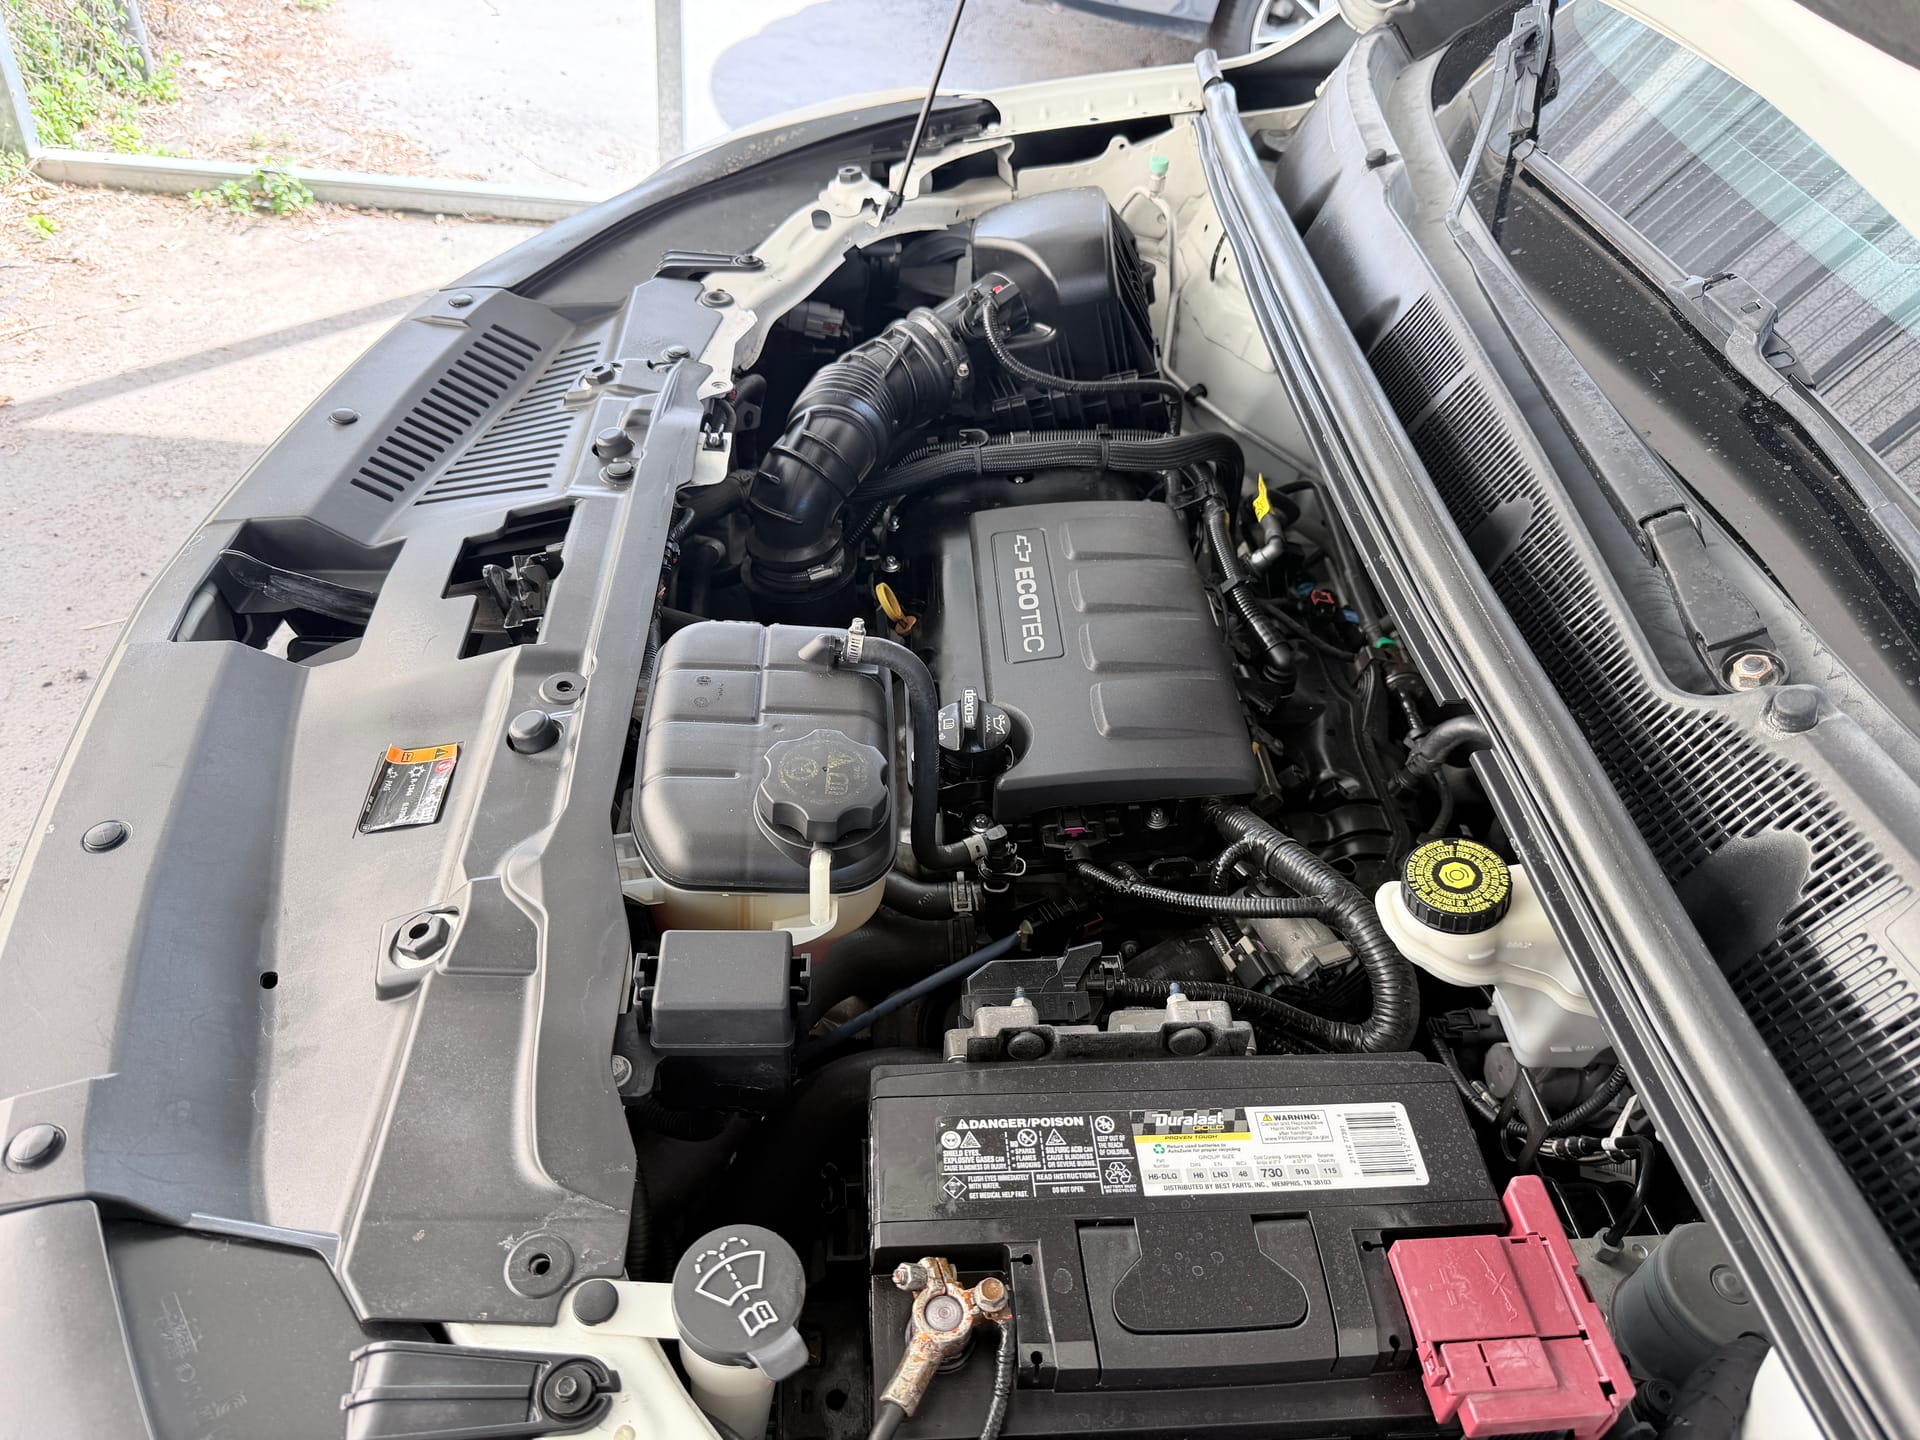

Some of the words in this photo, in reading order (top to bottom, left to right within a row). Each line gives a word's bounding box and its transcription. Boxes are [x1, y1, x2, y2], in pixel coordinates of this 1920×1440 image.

[1014, 566, 1045, 653] ECOTEC
[965, 690, 976, 724] dexos
[969, 1116, 1084, 1129] DANGER/POISON
[1152, 1112, 1224, 1126] Duralast
[1260, 1168, 1283, 1178] 730
